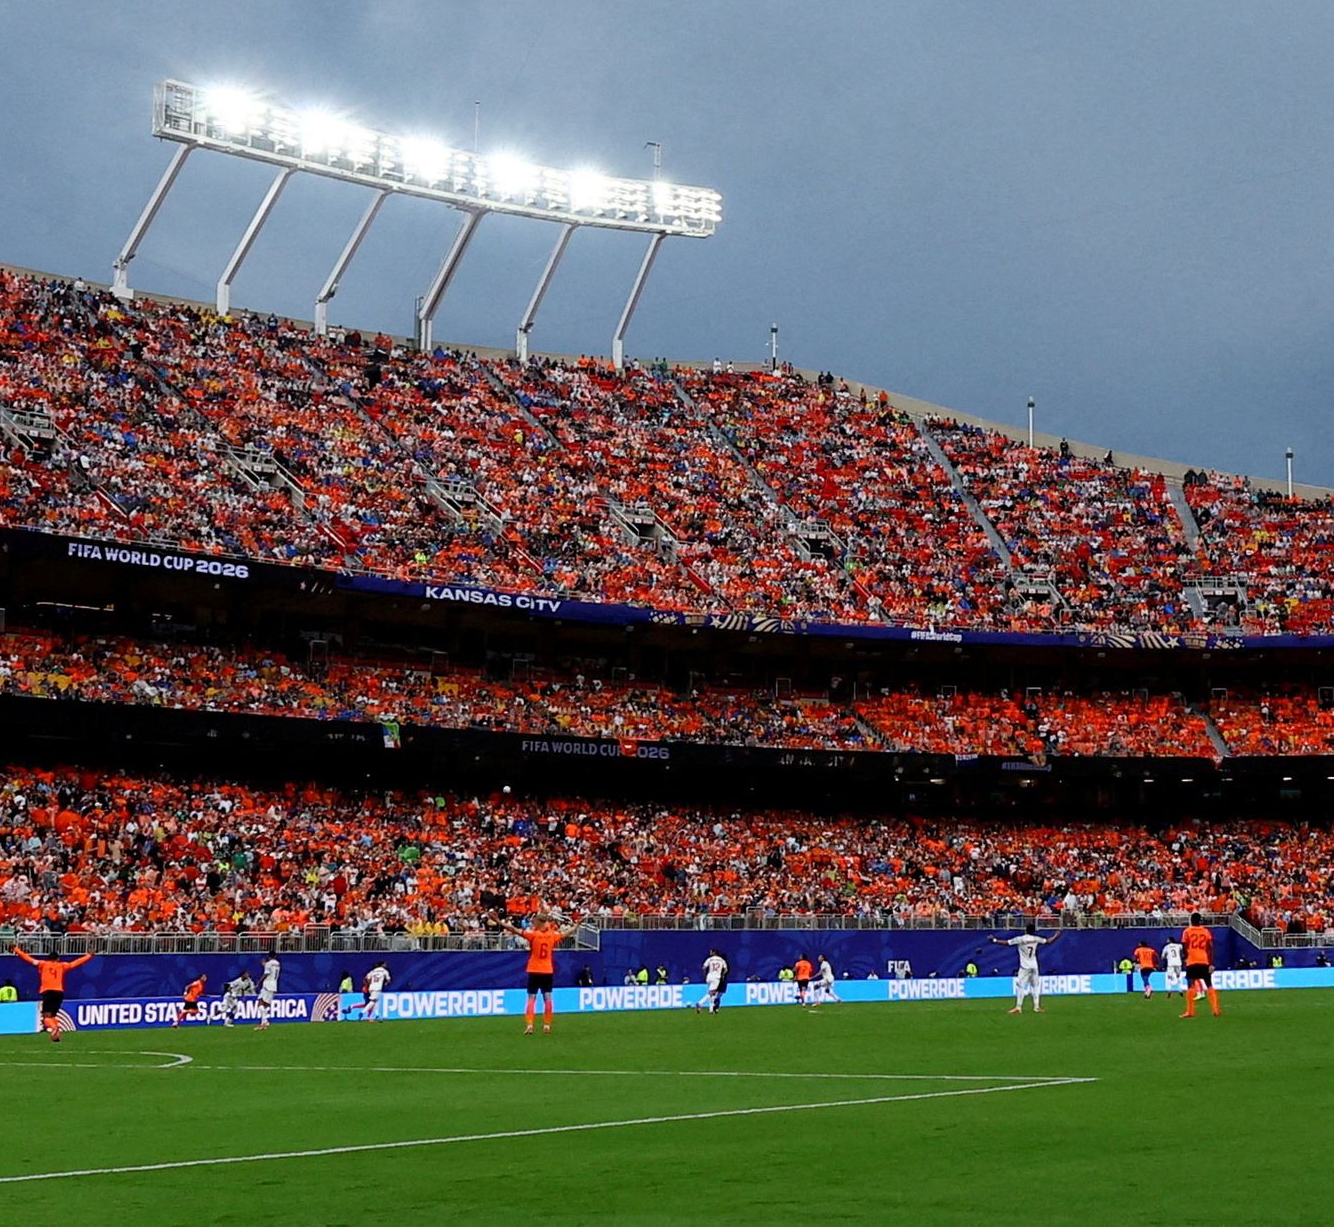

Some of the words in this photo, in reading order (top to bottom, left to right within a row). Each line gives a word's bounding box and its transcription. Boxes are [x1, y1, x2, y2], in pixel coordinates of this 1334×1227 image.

[67, 542, 102, 560] FIFA
[104, 547, 161, 567] WORLD
[163, 555, 194, 571] CUP
[195, 560, 249, 579] 2026
[425, 586, 512, 607] KANSAS
[516, 596, 561, 612] CITY
[522, 740, 550, 753] FIFA
[551, 742, 598, 755] WORLD
[579, 985, 683, 1010] POWERADE
[888, 978, 965, 999] POWERADE
[78, 1003, 142, 1026] UNITED
[234, 998, 307, 1020] AMRICA
[383, 990, 505, 1017] POWERADE
